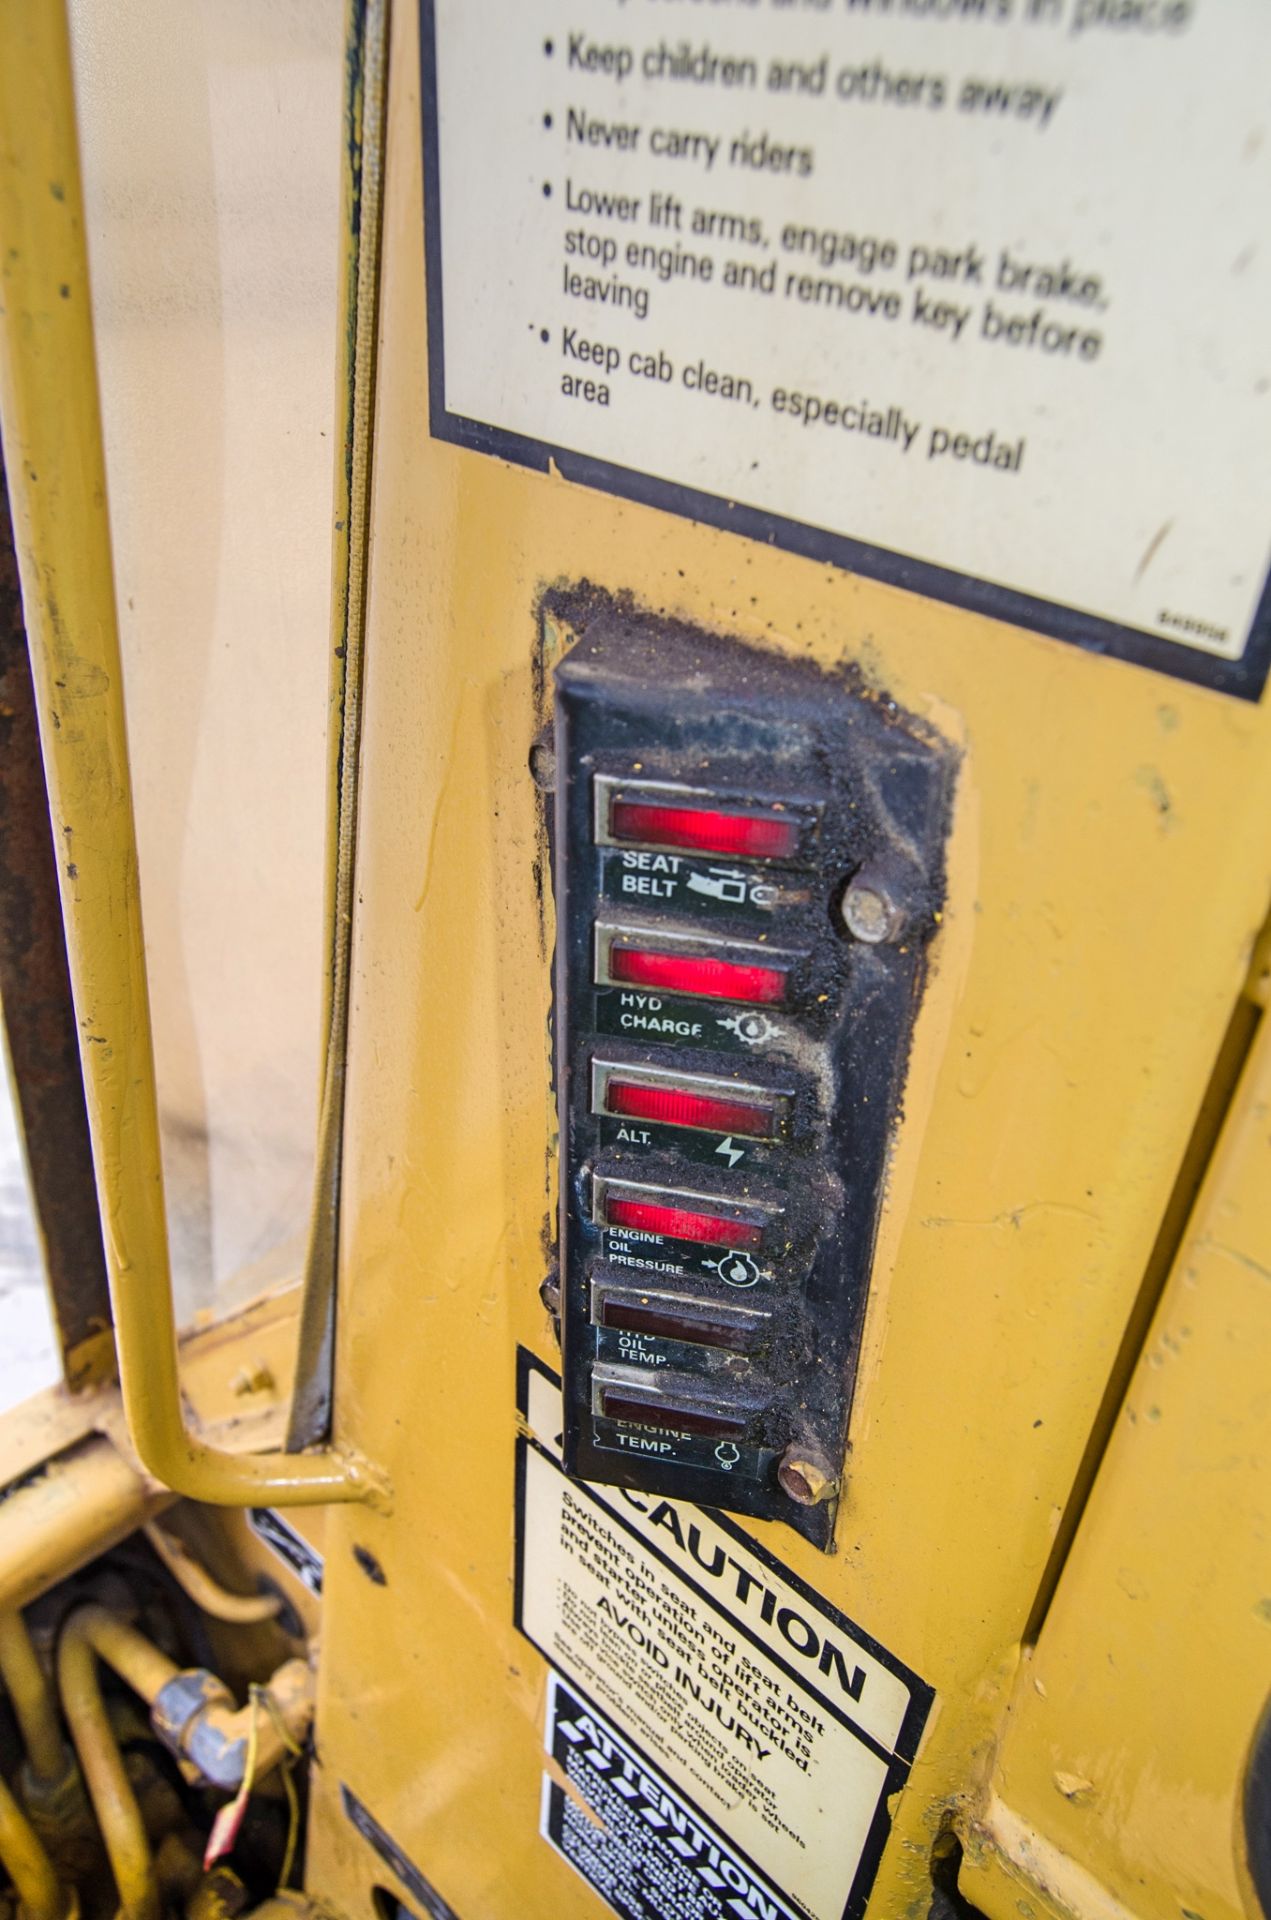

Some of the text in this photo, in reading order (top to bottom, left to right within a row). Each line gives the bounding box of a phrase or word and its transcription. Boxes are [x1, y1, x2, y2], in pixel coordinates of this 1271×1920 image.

[568, 33, 1062, 129] Keep children and others away
[566, 108, 814, 178] Never carry riders
[565, 179, 1109, 311] Lower lift arms, engage park brake,
[563, 265, 649, 319] leaving
[564, 228, 1103, 362] stop engine and remove key before
[561, 374, 610, 406] area
[562, 326, 1027, 474] Keep cab clean, especially pedal
[621, 851, 683, 874] SEAT
[621, 875, 678, 898] BELT
[620, 993, 662, 1012] HYD
[608, 1240, 632, 1253] OIL
[609, 1227, 664, 1245] ENGINE
[609, 1253, 684, 1275] PRESSURE
[618, 1337, 647, 1351] OIL
[616, 1433, 677, 1456] TEMP.
[561, 1519, 587, 1553] and
[594, 1550, 646, 1607] starter
[652, 1604, 705, 1662] unless
[711, 1659, 789, 1741] operator
[562, 1489, 825, 1736] Switches in seat and seat belt
[562, 1505, 813, 1744] prevent operation of lift arms
[620, 1487, 867, 1704] CAUTION
[560, 1533, 812, 1777] in seat with seat belt buckled.
[596, 1590, 771, 1768] AVOID INJURY
[667, 1743, 686, 1766] and
[690, 1766, 730, 1811] contact
[671, 1725, 710, 1768] parking
[713, 1765, 744, 1799] brake
[761, 1813, 778, 1833] set
[684, 1718, 723, 1760] around
[727, 1760, 777, 1811] operator
[687, 1711, 728, 1755] objects
[732, 1754, 746, 1772] on
[751, 1772, 775, 1799] seat
[687, 1730, 716, 1762] when
[721, 1763, 756, 1801] loader
[763, 1804, 805, 1849] wheels
[573, 1714, 778, 1920] ATTENTION
